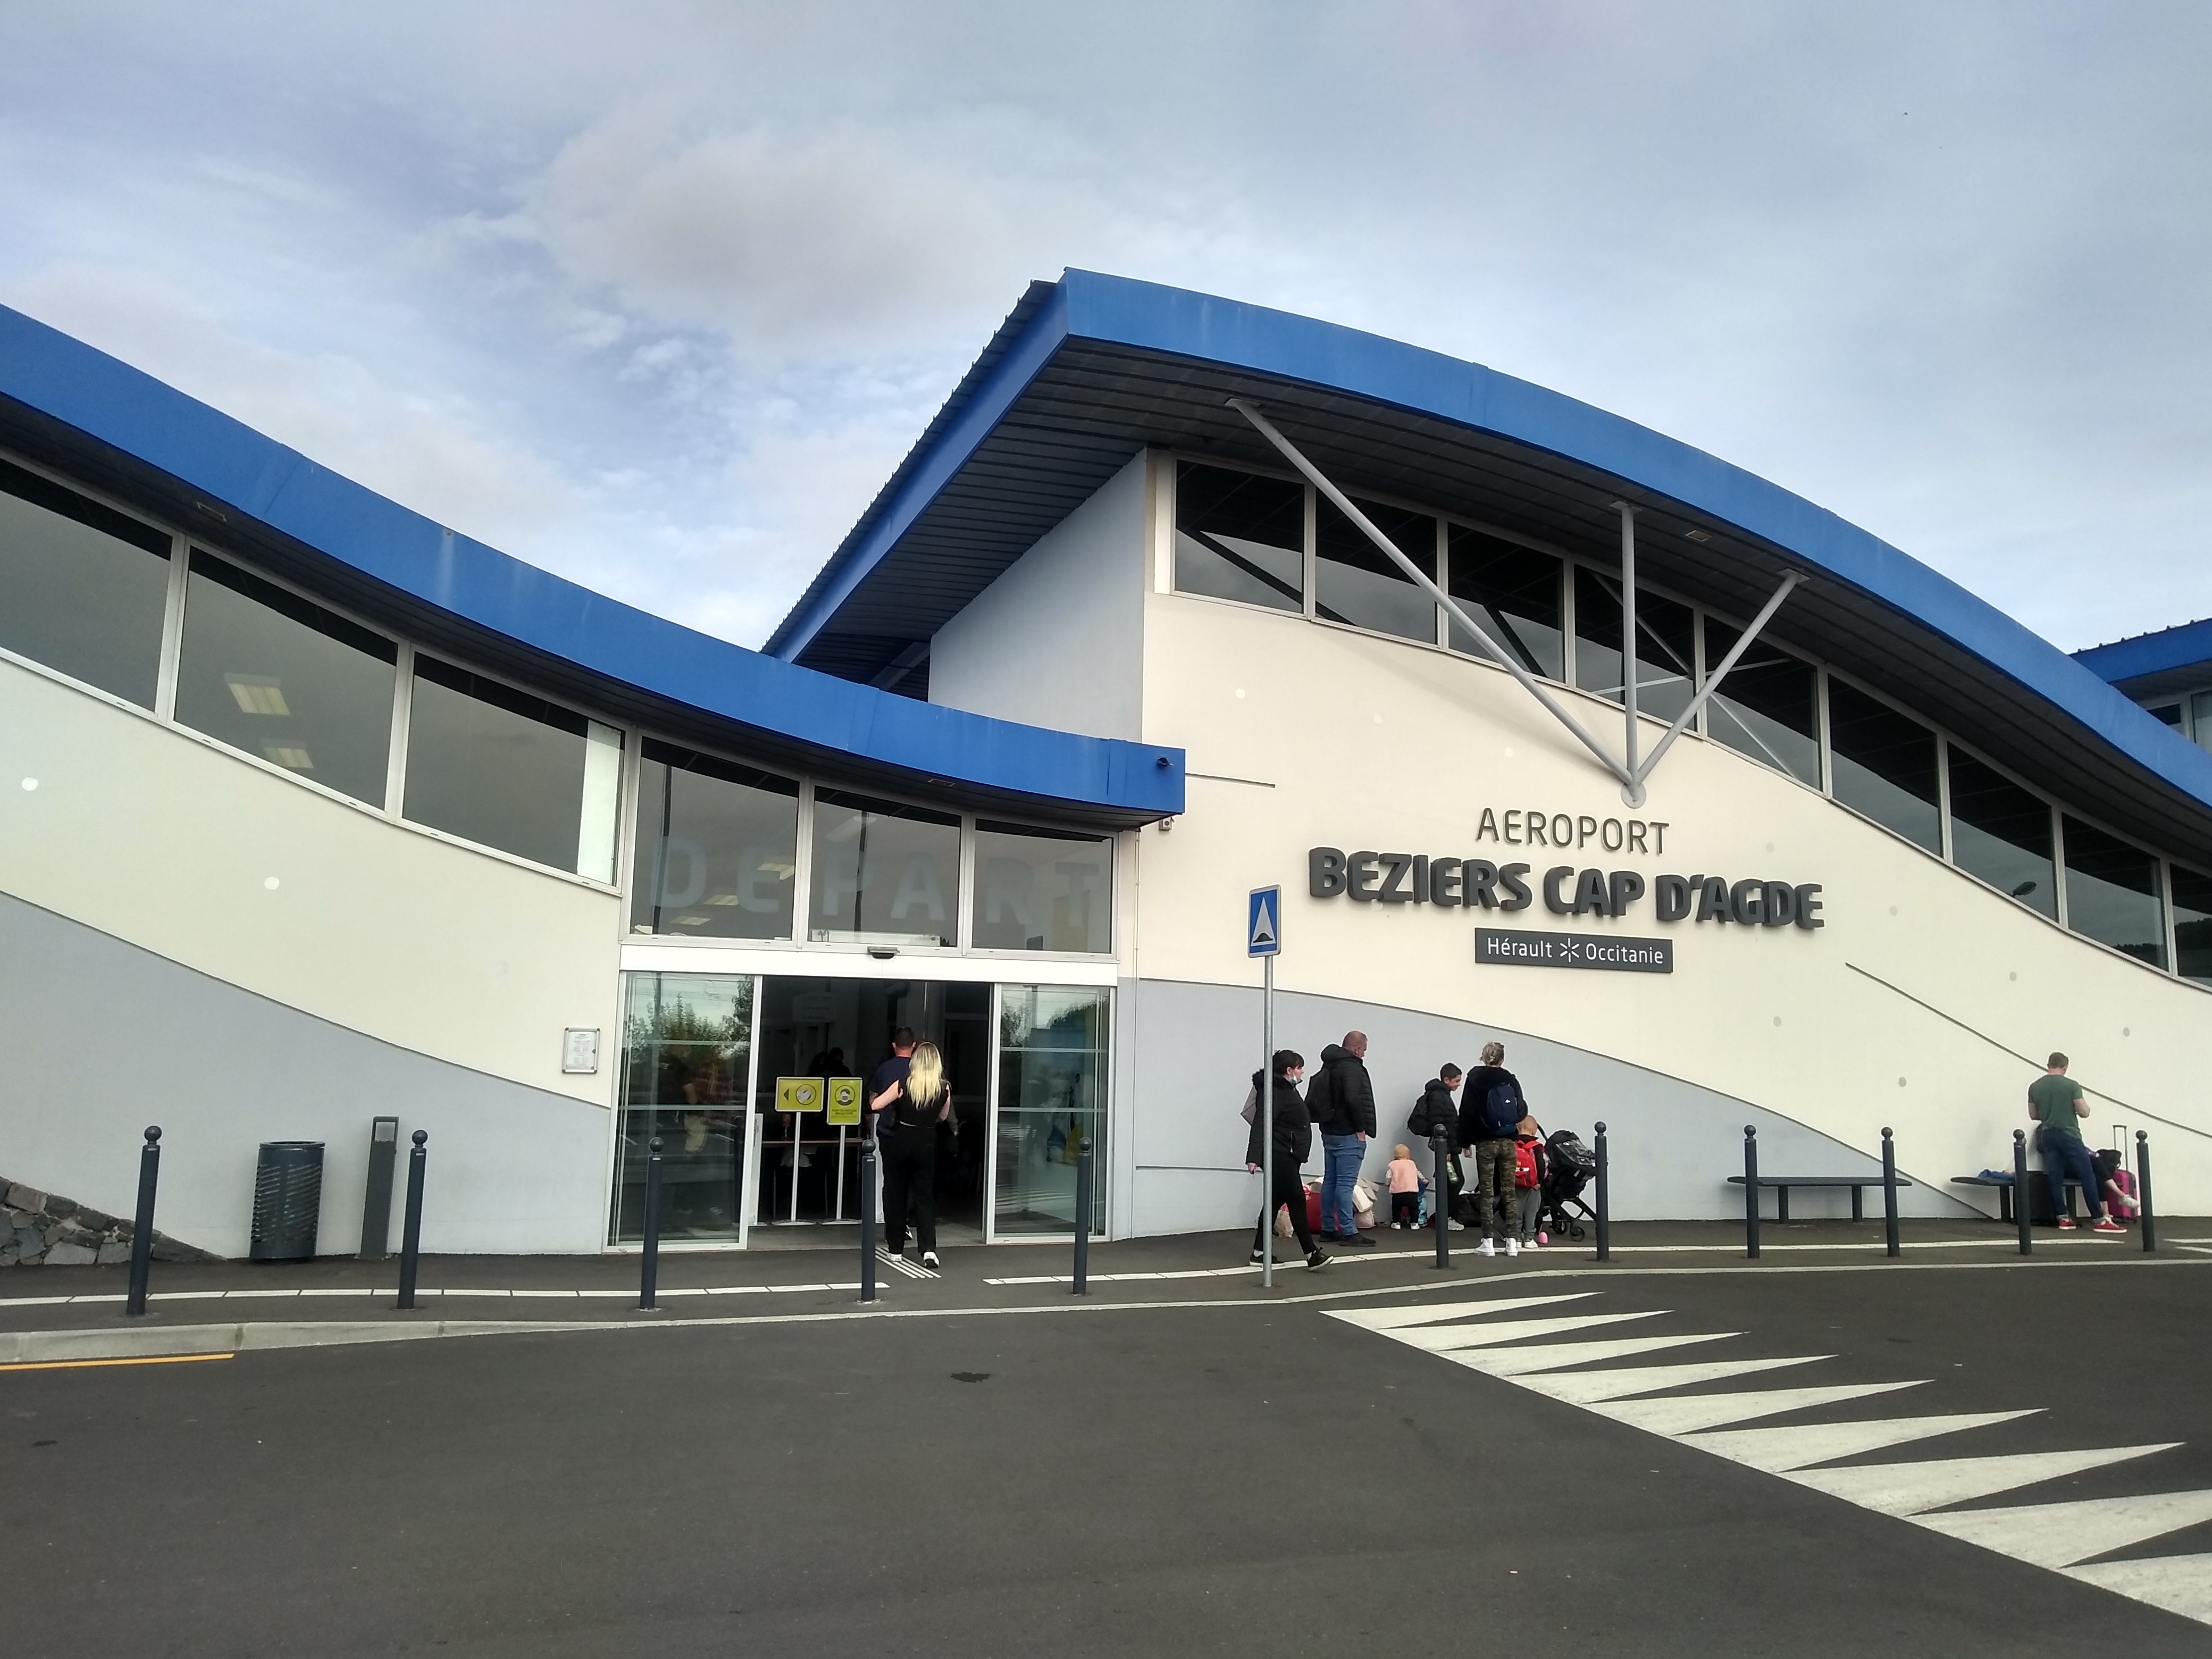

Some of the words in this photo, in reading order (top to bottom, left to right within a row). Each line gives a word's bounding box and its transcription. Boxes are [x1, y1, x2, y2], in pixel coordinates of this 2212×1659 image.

[1476, 808, 1669, 854] AEROPORT
[649, 835, 1101, 929] DEPART
[1309, 847, 1532, 911] BEZIERS
[1544, 866, 1645, 917] CAP
[1656, 874, 1825, 929] D'AGDE
[1488, 937, 1553, 958] Hérault
[1586, 943, 1664, 964] Occitanie
